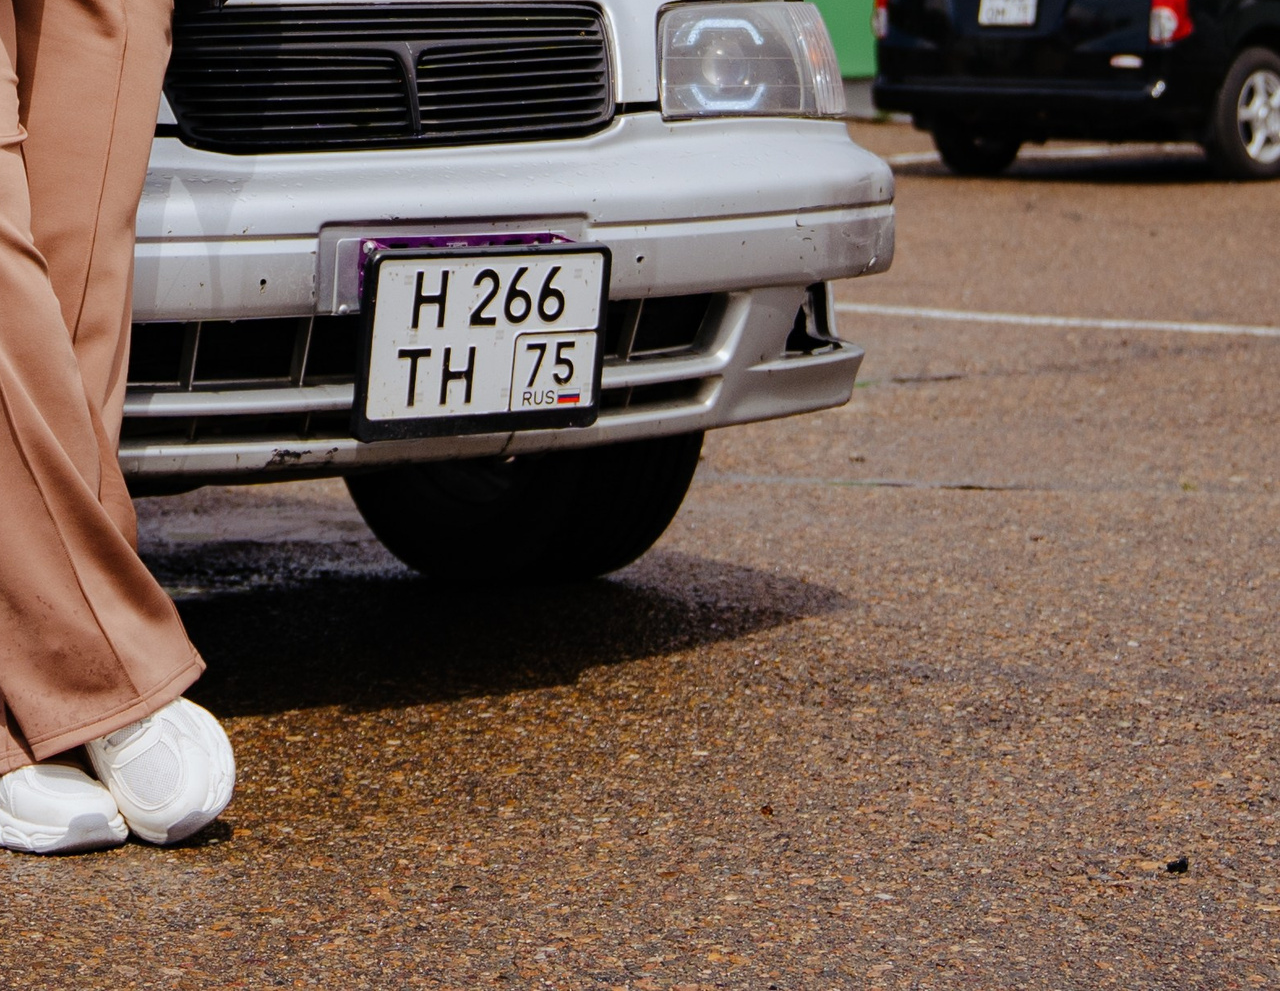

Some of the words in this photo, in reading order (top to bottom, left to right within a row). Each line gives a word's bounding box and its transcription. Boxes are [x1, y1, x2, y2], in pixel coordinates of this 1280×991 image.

[411, 270, 449, 329] Н
[470, 266, 565, 326] 266
[398, 346, 476, 407] ТН
[525, 341, 575, 387] 75
[522, 390, 555, 406] RUS
